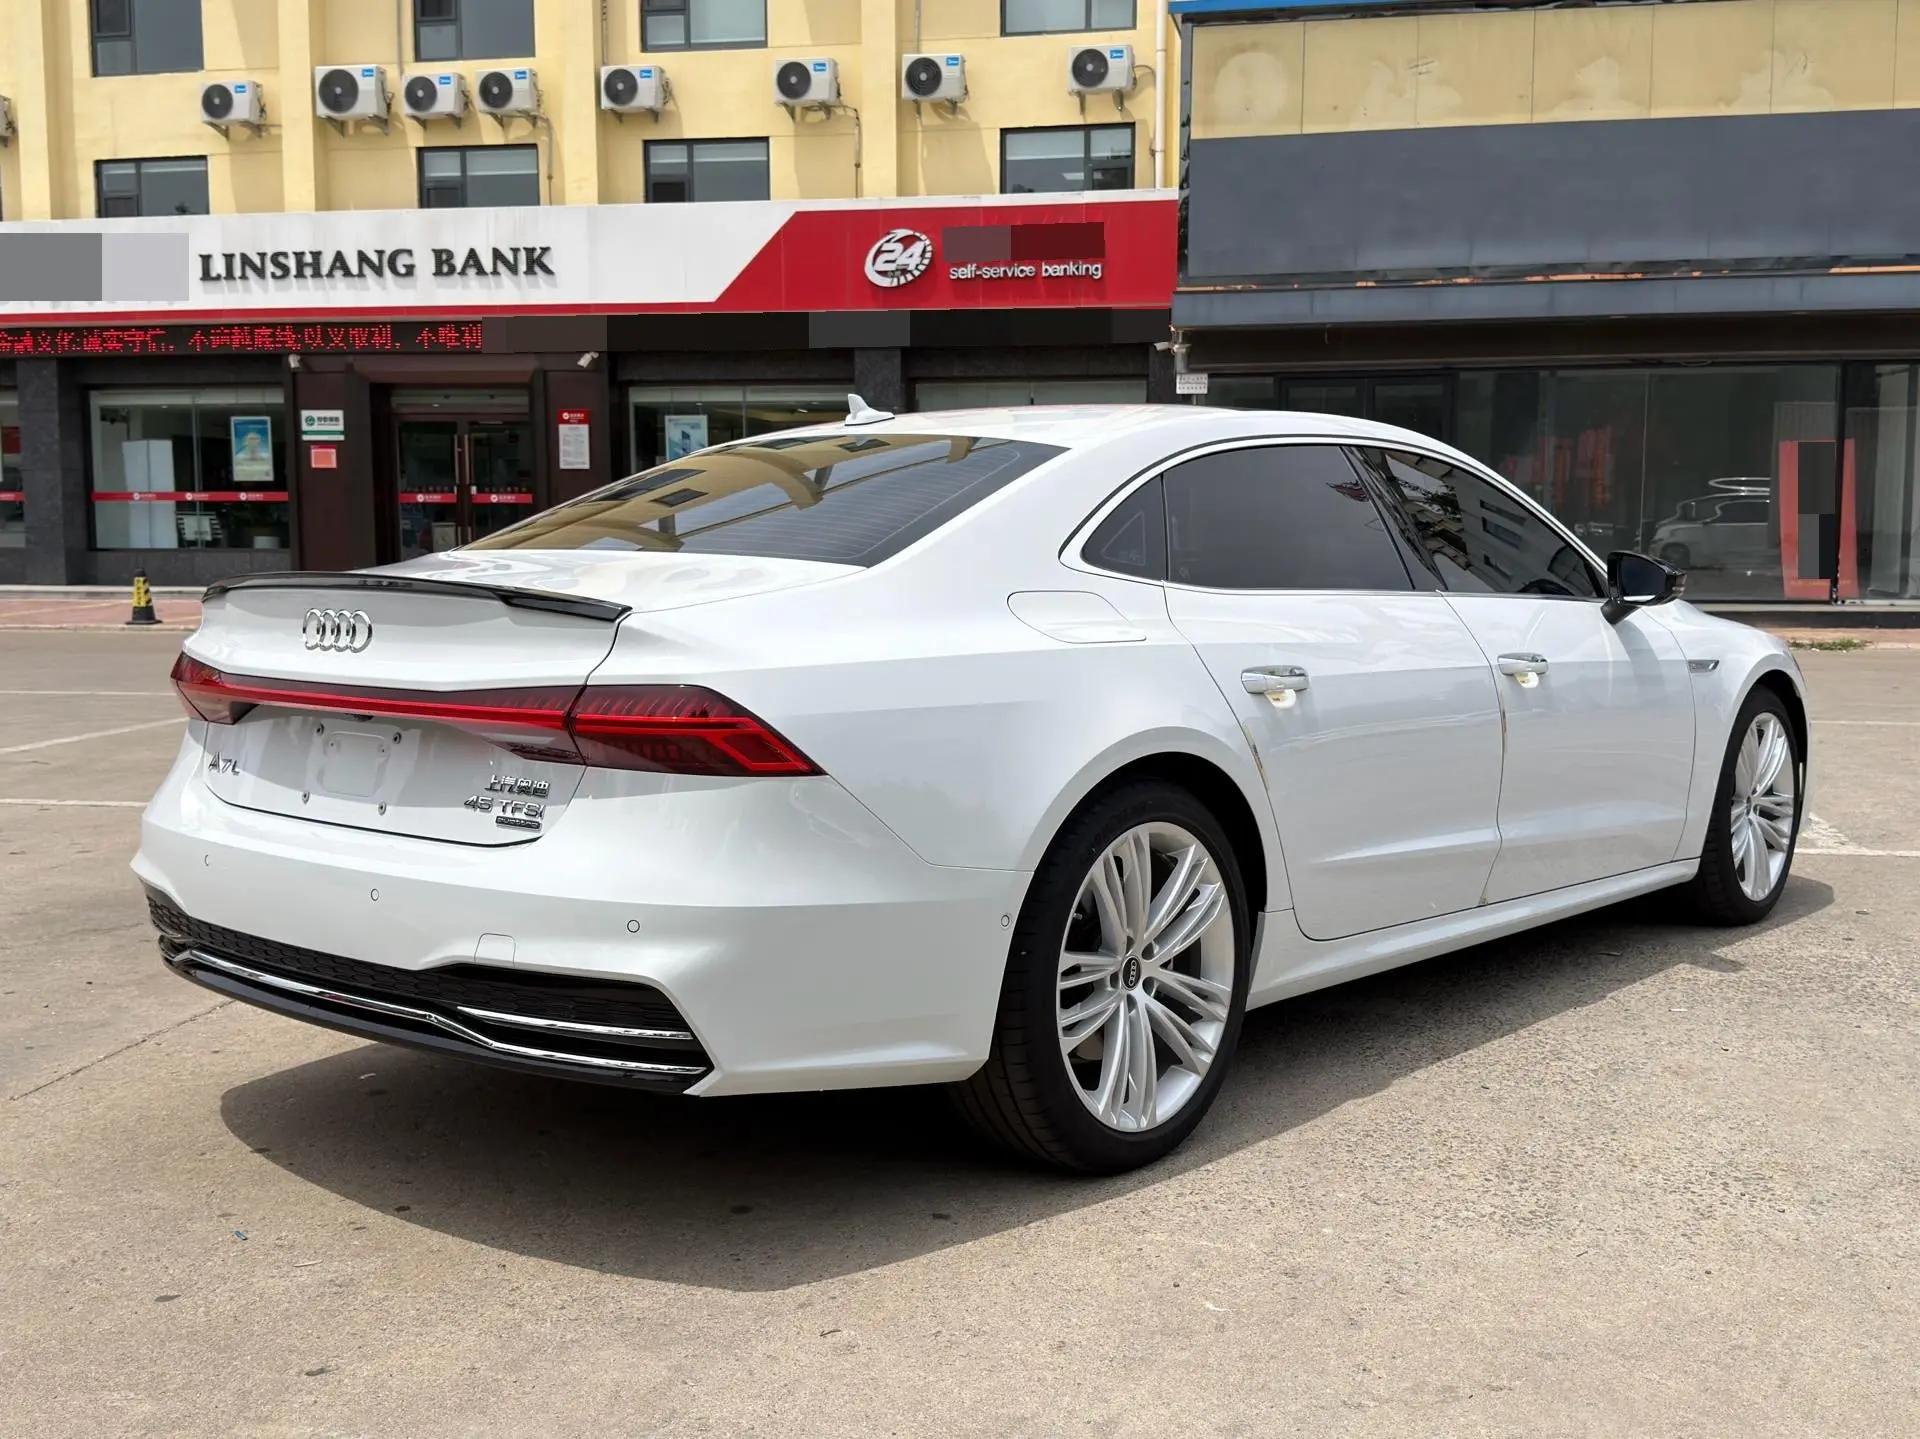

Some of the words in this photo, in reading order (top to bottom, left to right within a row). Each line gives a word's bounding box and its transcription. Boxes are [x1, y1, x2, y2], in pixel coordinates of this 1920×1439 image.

[199, 249, 416, 281] LINSHANG
[432, 246, 555, 277] BANK
[873, 240, 926, 271] 24
[949, 263, 1036, 280] self-service
[1041, 261, 1102, 280] banking
[207, 751, 240, 776] A7L
[484, 774, 551, 798] 上汽奥迪
[463, 795, 494, 813] 45
[499, 798, 547, 820] TFSI
